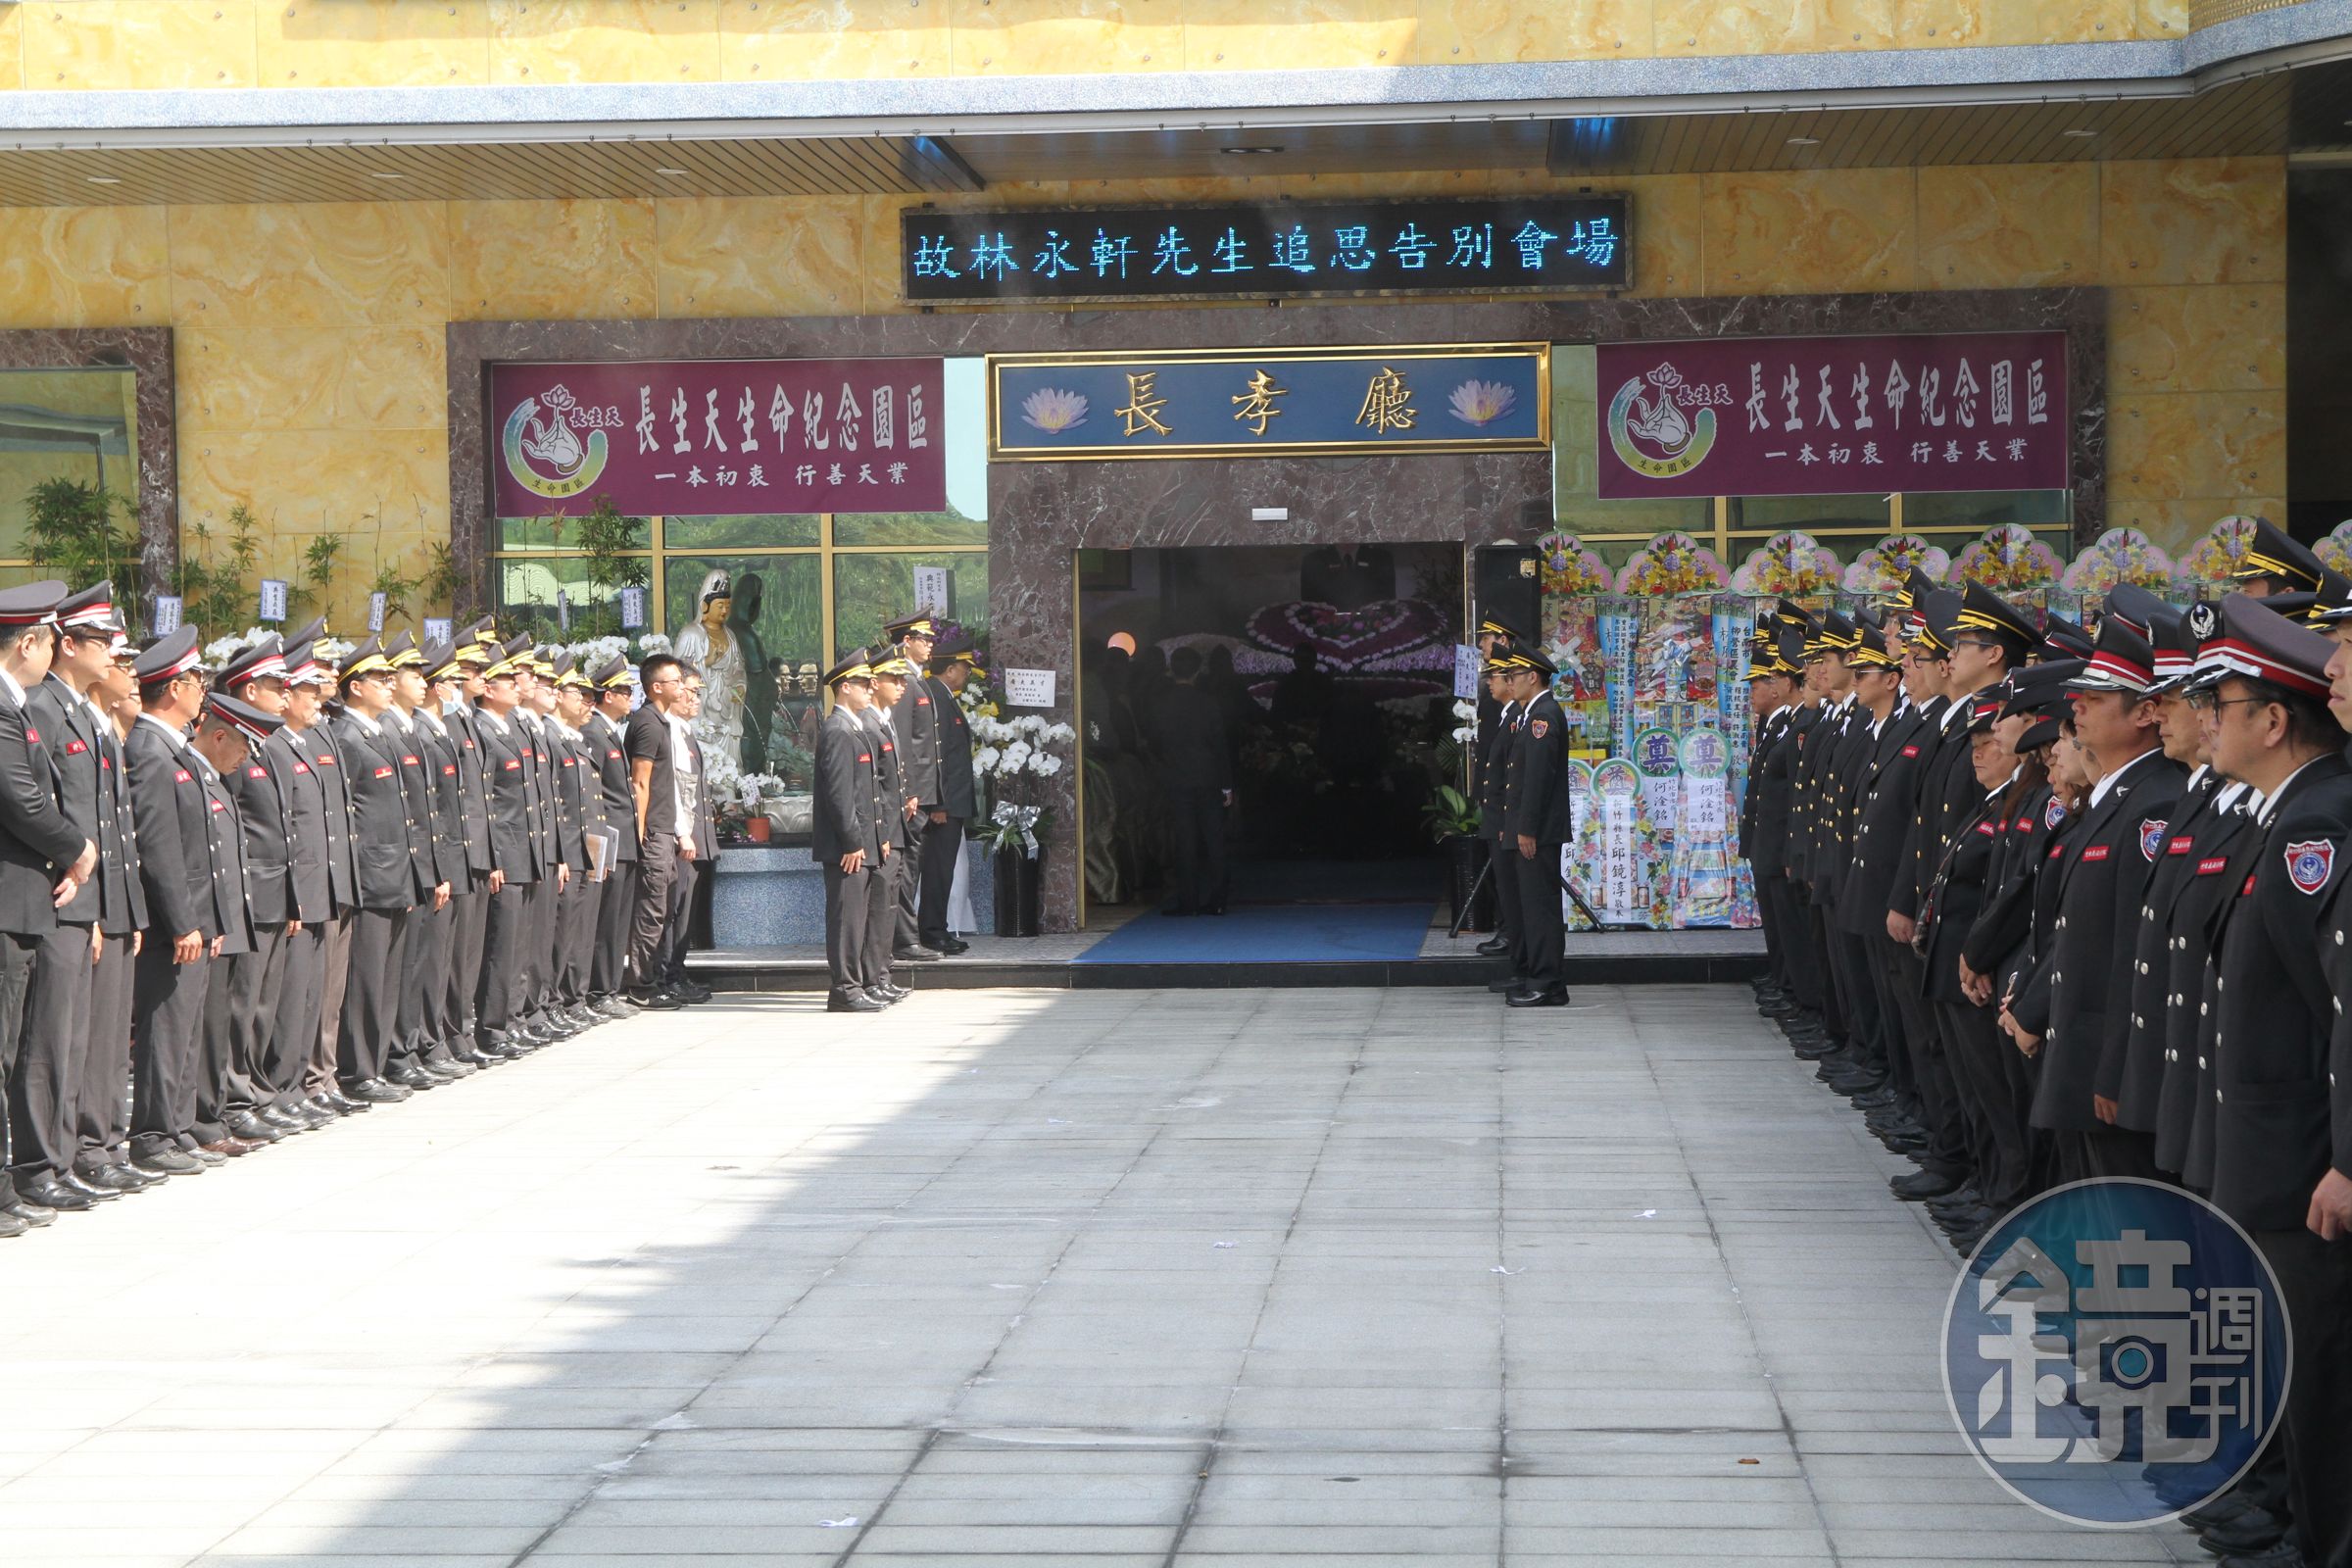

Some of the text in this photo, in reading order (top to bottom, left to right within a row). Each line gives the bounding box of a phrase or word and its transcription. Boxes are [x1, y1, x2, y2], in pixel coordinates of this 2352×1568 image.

[912, 217, 1618, 281] 故林永軒先生追思告別會場
[1676, 383, 1734, 406] 長生天
[1744, 358, 2048, 433] 長生天生命紀念園區
[570, 406, 624, 428] 長生天
[635, 382, 929, 456] 長生天生命紀念園區
[1765, 438, 2029, 466] 一本初衷 行善天業
[655, 463, 909, 488] 一本初衷 行善天業
[1642, 734, 1678, 771] 奠
[1689, 734, 1722, 771] 奠
